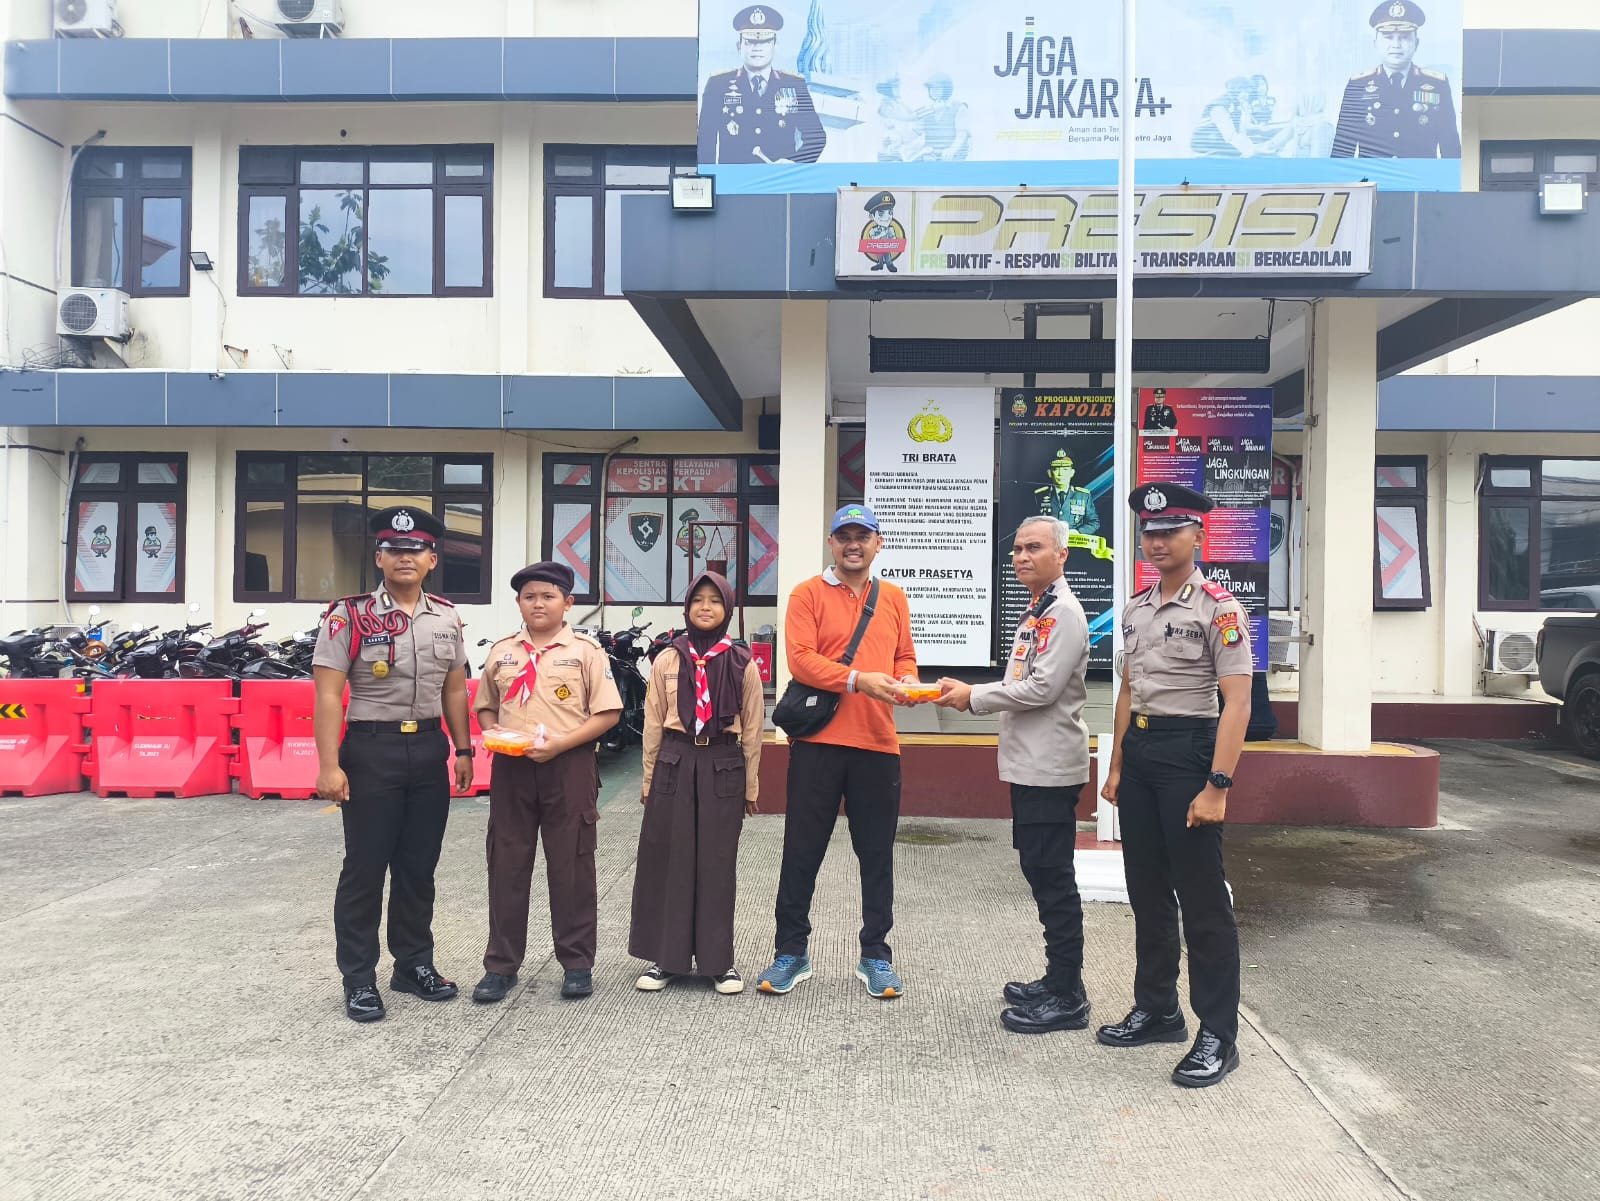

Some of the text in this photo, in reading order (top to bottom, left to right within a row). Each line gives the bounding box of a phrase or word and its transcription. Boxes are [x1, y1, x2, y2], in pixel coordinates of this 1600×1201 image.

[994, 31, 1077, 77] JAGA
[1014, 78, 1172, 119] JAKARA+
[1153, 135, 1172, 143] Jaya
[921, 192, 1350, 251] PRESISI
[920, 253, 992, 270] PREDIKTIF
[1004, 251, 1117, 269] RESPONSIBILITA
[1141, 251, 1250, 267] TRANSPARANSI
[1254, 250, 1352, 267] BERKEADILAN
[1034, 403, 1112, 417] KAPOLR
[633, 460, 667, 468] SENTRA
[902, 453, 957, 463] TRI BRATA
[1206, 457, 1229, 469] JAGA
[616, 467, 667, 475] KEPOLISIAN
[1214, 469, 1269, 479] LINGKUNGAN
[881, 568, 973, 579] CATUR PRASETYA
[1206, 568, 1230, 580] JAGA
